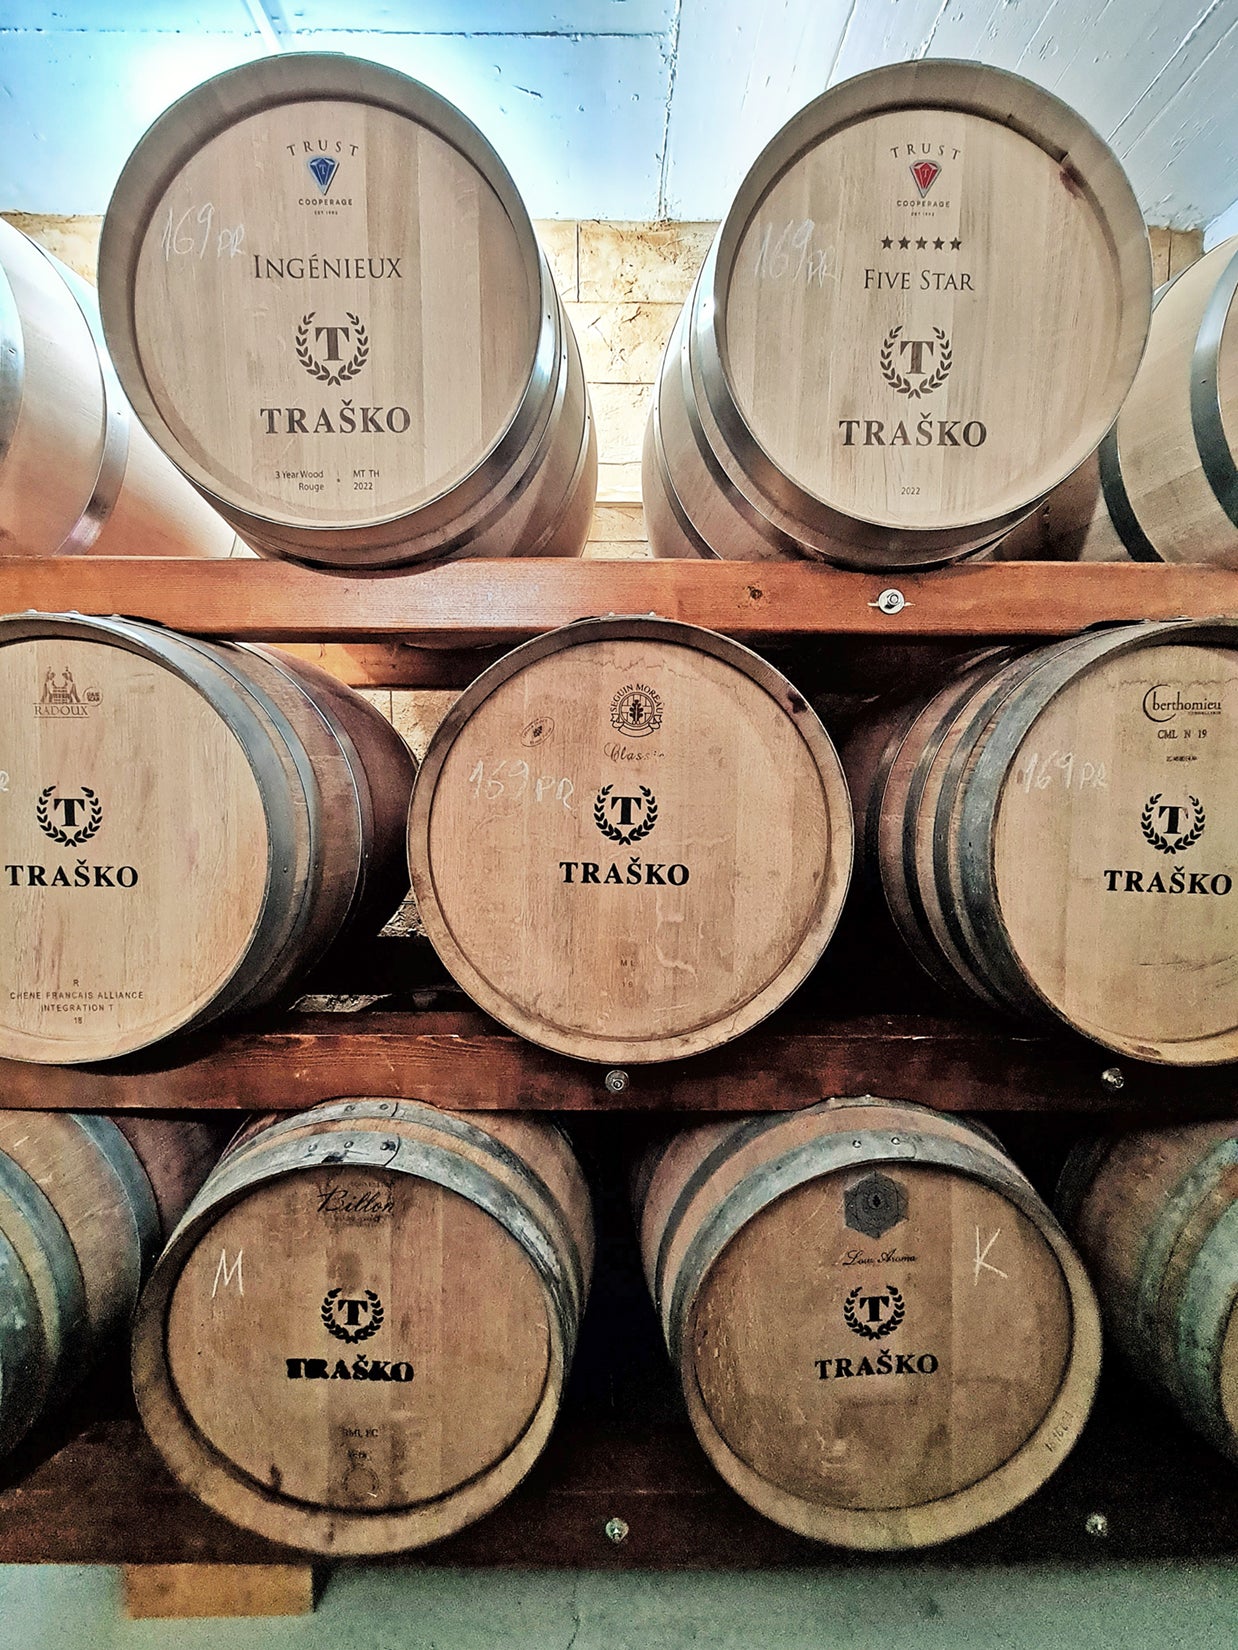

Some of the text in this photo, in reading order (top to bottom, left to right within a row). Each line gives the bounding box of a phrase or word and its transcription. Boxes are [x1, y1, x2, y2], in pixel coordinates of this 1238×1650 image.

[286, 139, 359, 157] TRUST
[889, 142, 961, 160] TRUST
[298, 198, 353, 206] COOPERAGE
[896, 200, 951, 208] COOPERAGE
[161, 202, 215, 262] 169
[315, 326, 350, 362] T
[900, 340, 934, 375] T
[260, 399, 411, 435] TRAŠKO
[838, 412, 988, 448] TRAŠKO
[275, 470, 324, 479] 3 Year Wood
[299, 482, 324, 492] Rouge
[353, 470, 380, 478] MT TH
[353, 482, 373, 491] 2022
[900, 486, 921, 496] 2022
[34, 705, 89, 716] RADOUX
[609, 683, 664, 714] SEGUIN MOREAU
[1184, 730, 1191, 739] N
[1198, 729, 1208, 739] 19
[53, 798, 85, 827] T
[611, 796, 642, 826] T
[1158, 806, 1190, 835] T
[4, 859, 139, 888] TRAŠKO
[559, 856, 690, 887] TRAŠKO
[1103, 865, 1233, 896] TRAŠKO
[10, 991, 144, 1000] CHENE FRANCAIS ALLIANCE
[73, 979, 79, 987] R
[41, 1003, 105, 1012] INTEGRATION
[317, 1185, 395, 1214] Billon
[877, 1248, 918, 1264] Aroma
[972, 1225, 1009, 1286] K
[211, 1248, 245, 1298] M
[337, 1299, 369, 1326] T
[859, 1295, 890, 1323] T
[285, 1353, 415, 1383] TRAŠKO
[814, 1348, 940, 1381] TRAŠKO
